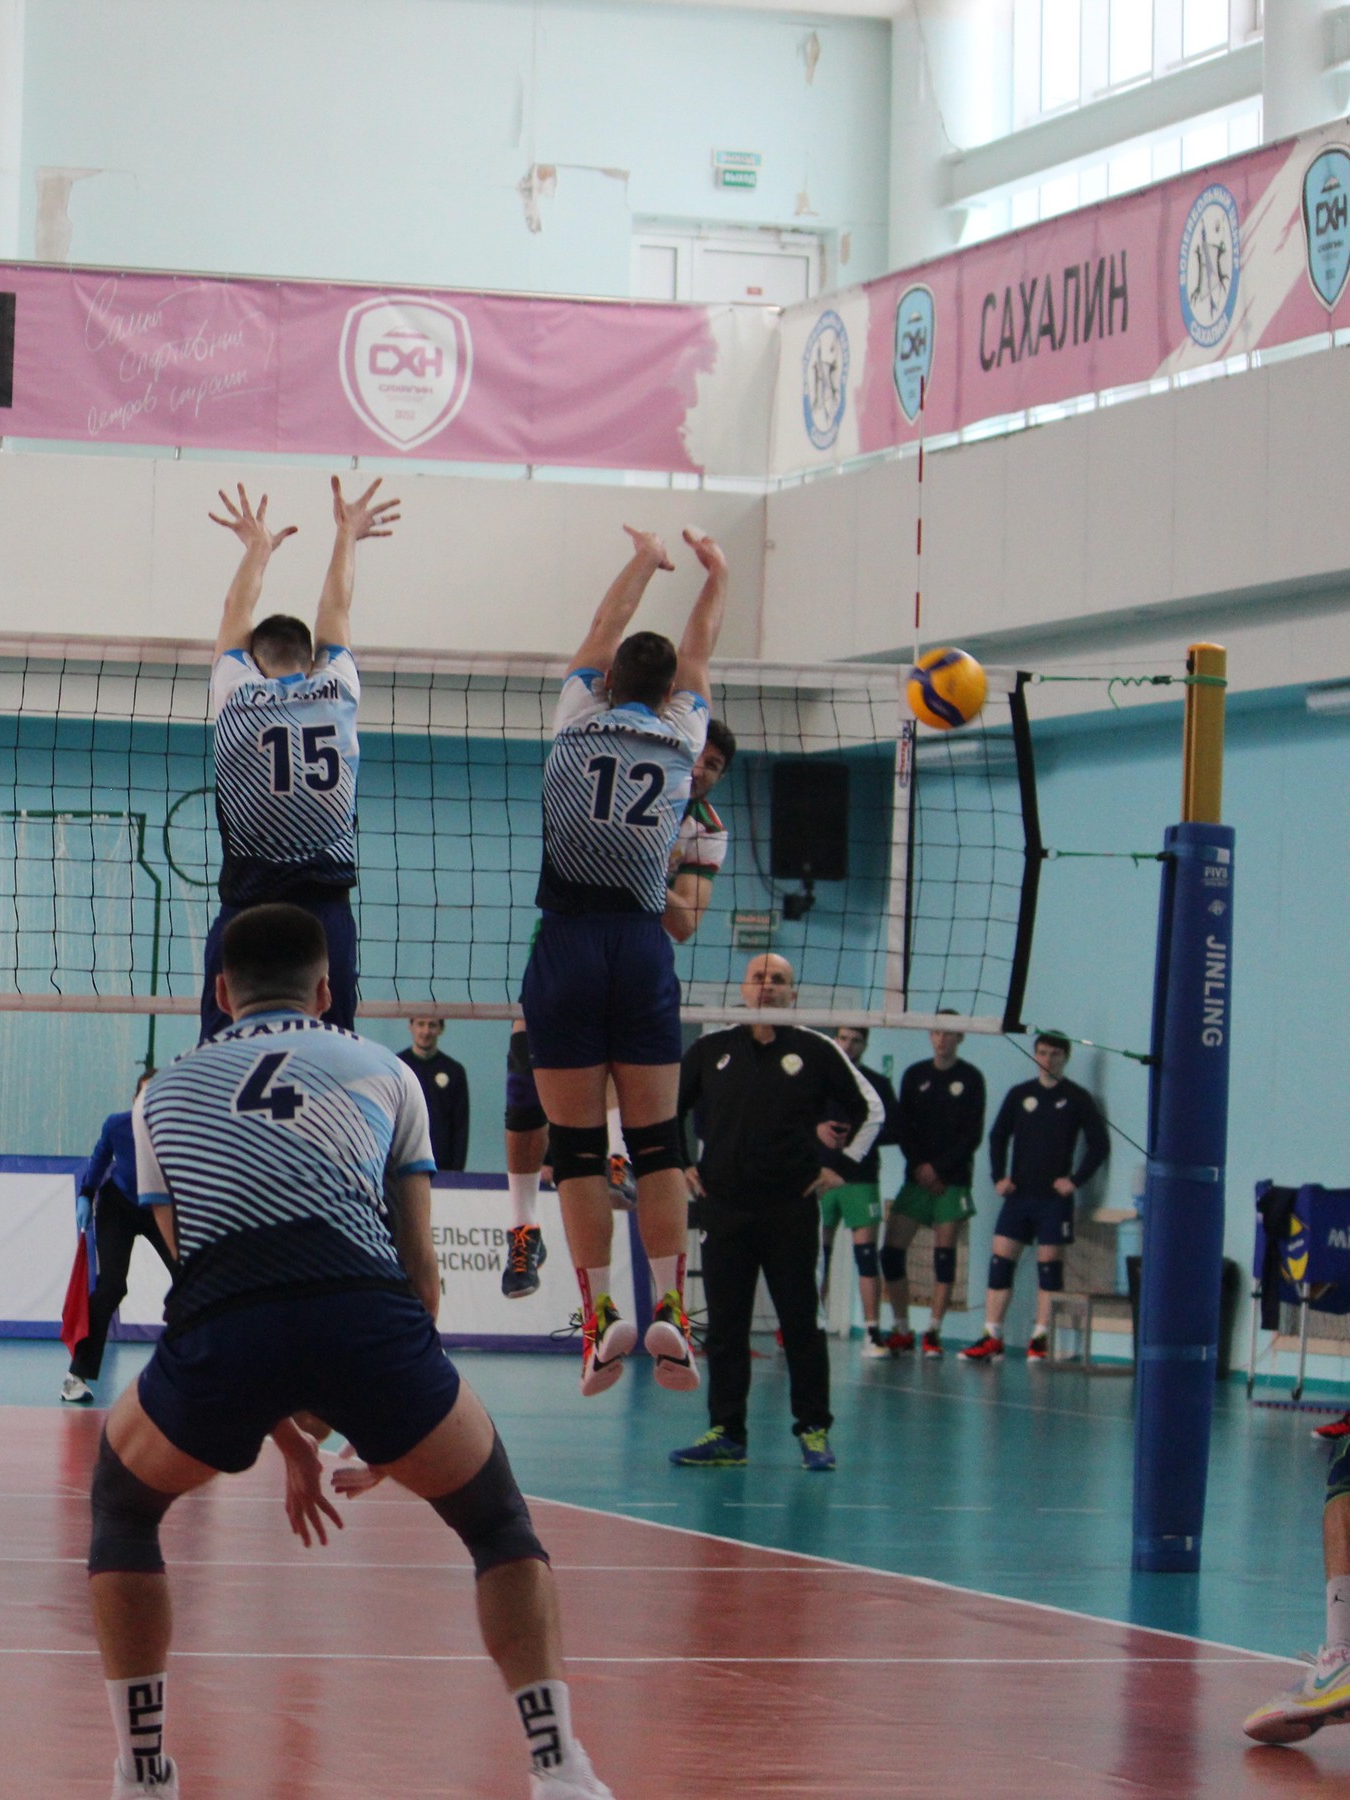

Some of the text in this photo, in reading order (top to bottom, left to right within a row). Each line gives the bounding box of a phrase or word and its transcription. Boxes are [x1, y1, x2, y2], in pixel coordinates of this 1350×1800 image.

[979, 249, 1129, 372] САХАЛИН
[261, 724, 340, 793] 15
[587, 754, 665, 827] 12
[1202, 934, 1226, 1047] JINLING
[235, 1050, 305, 1121] 4
